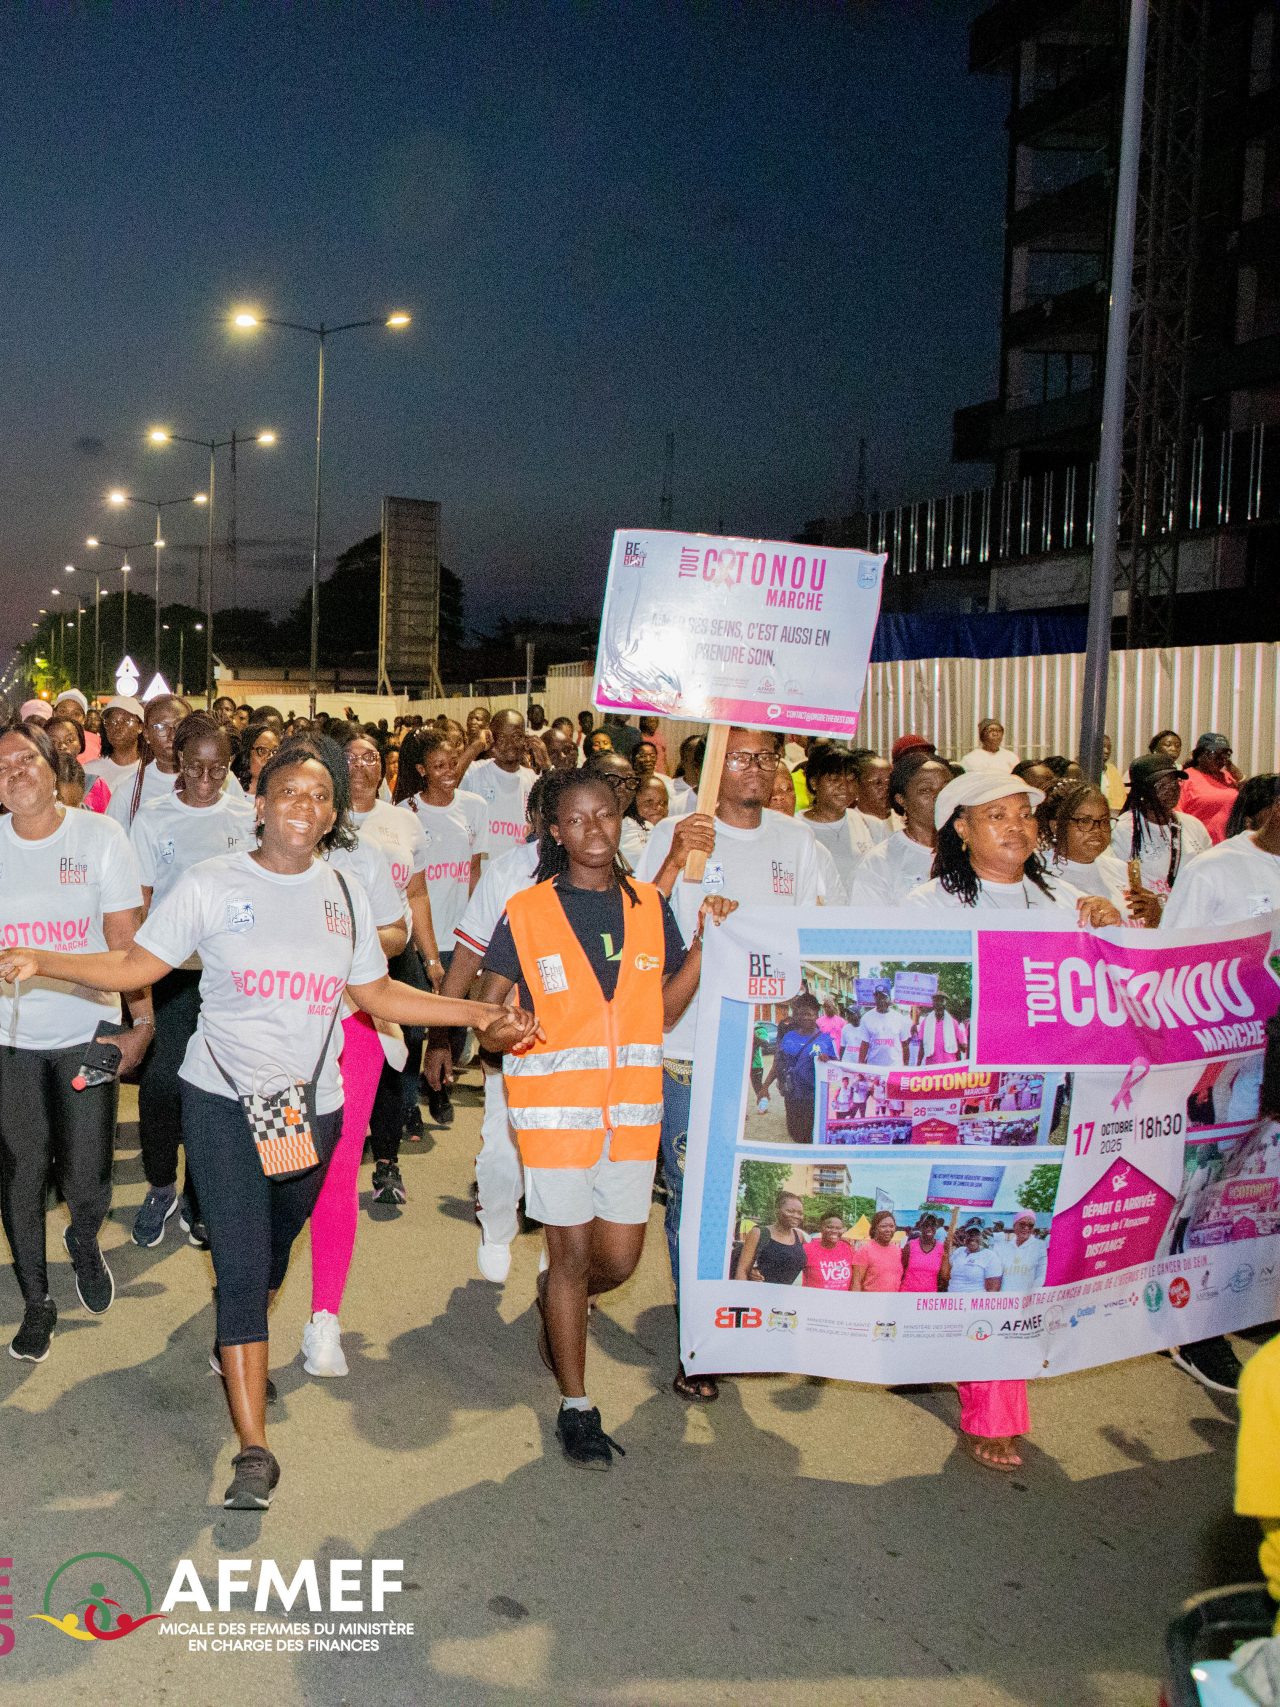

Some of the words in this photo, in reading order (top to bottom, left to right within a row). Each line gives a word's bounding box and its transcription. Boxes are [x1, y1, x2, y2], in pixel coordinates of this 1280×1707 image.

[625, 541, 640, 555] BE
[678, 546, 701, 578] TOUT
[765, 589, 824, 611] MARCHE
[710, 618, 744, 641] SEINS,
[747, 622, 778, 641] C'EST
[780, 625, 813, 645] AUSSI
[815, 629, 830, 647] EN
[747, 647, 776, 667] SOIN.
[60, 857, 74, 872] BE
[771, 861, 783, 880] BE
[60, 871, 87, 884] BEST
[773, 877, 794, 894] BEST
[324, 900, 339, 920] BE
[749, 952, 773, 978] BE
[748, 977, 786, 996] BEST
[1022, 956, 1058, 1027] TOUT
[1058, 956, 1256, 1030] COTONOU
[1192, 1020, 1266, 1053] MARCHE
[913, 1106, 927, 1117] 26
[1072, 1121, 1095, 1157] 17
[1101, 1119, 1134, 1136] OCTOBRE
[1138, 1113, 1182, 1140] 18h30
[1100, 1138, 1122, 1154] 2025
[1082, 1200, 1115, 1219] DÉPART
[916, 1298, 967, 1312] ENSEMBLE,
[970, 1295, 1019, 1311] MARCHONS
[1047, 1289, 1056, 1302] LE
[1000, 1315, 1043, 1332] AFMEF
